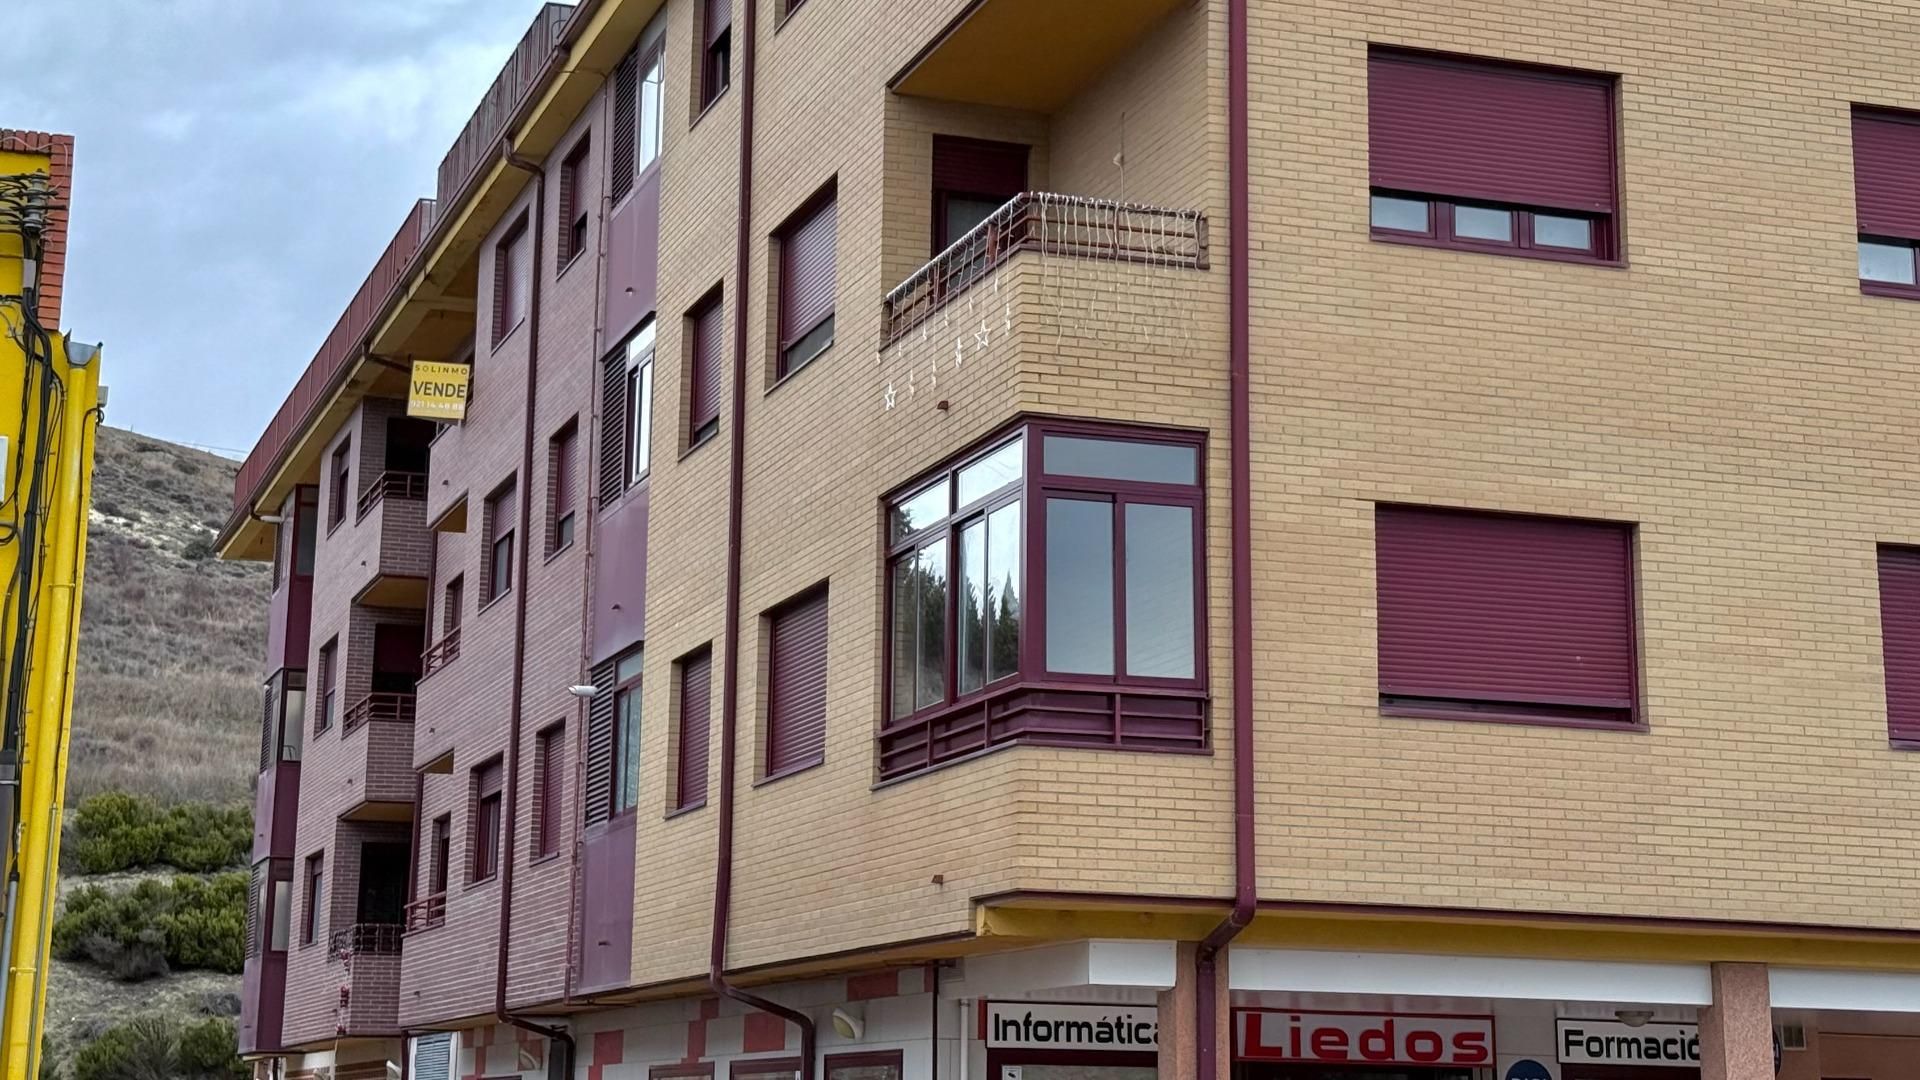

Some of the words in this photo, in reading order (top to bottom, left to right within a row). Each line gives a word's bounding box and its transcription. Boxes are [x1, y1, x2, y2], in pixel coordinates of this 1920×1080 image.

[415, 364, 468, 375] SOLINMO
[413, 381, 467, 398] VENDE
[994, 1011, 1158, 1044] Informátic
[1244, 1012, 1489, 1062] Liedos
